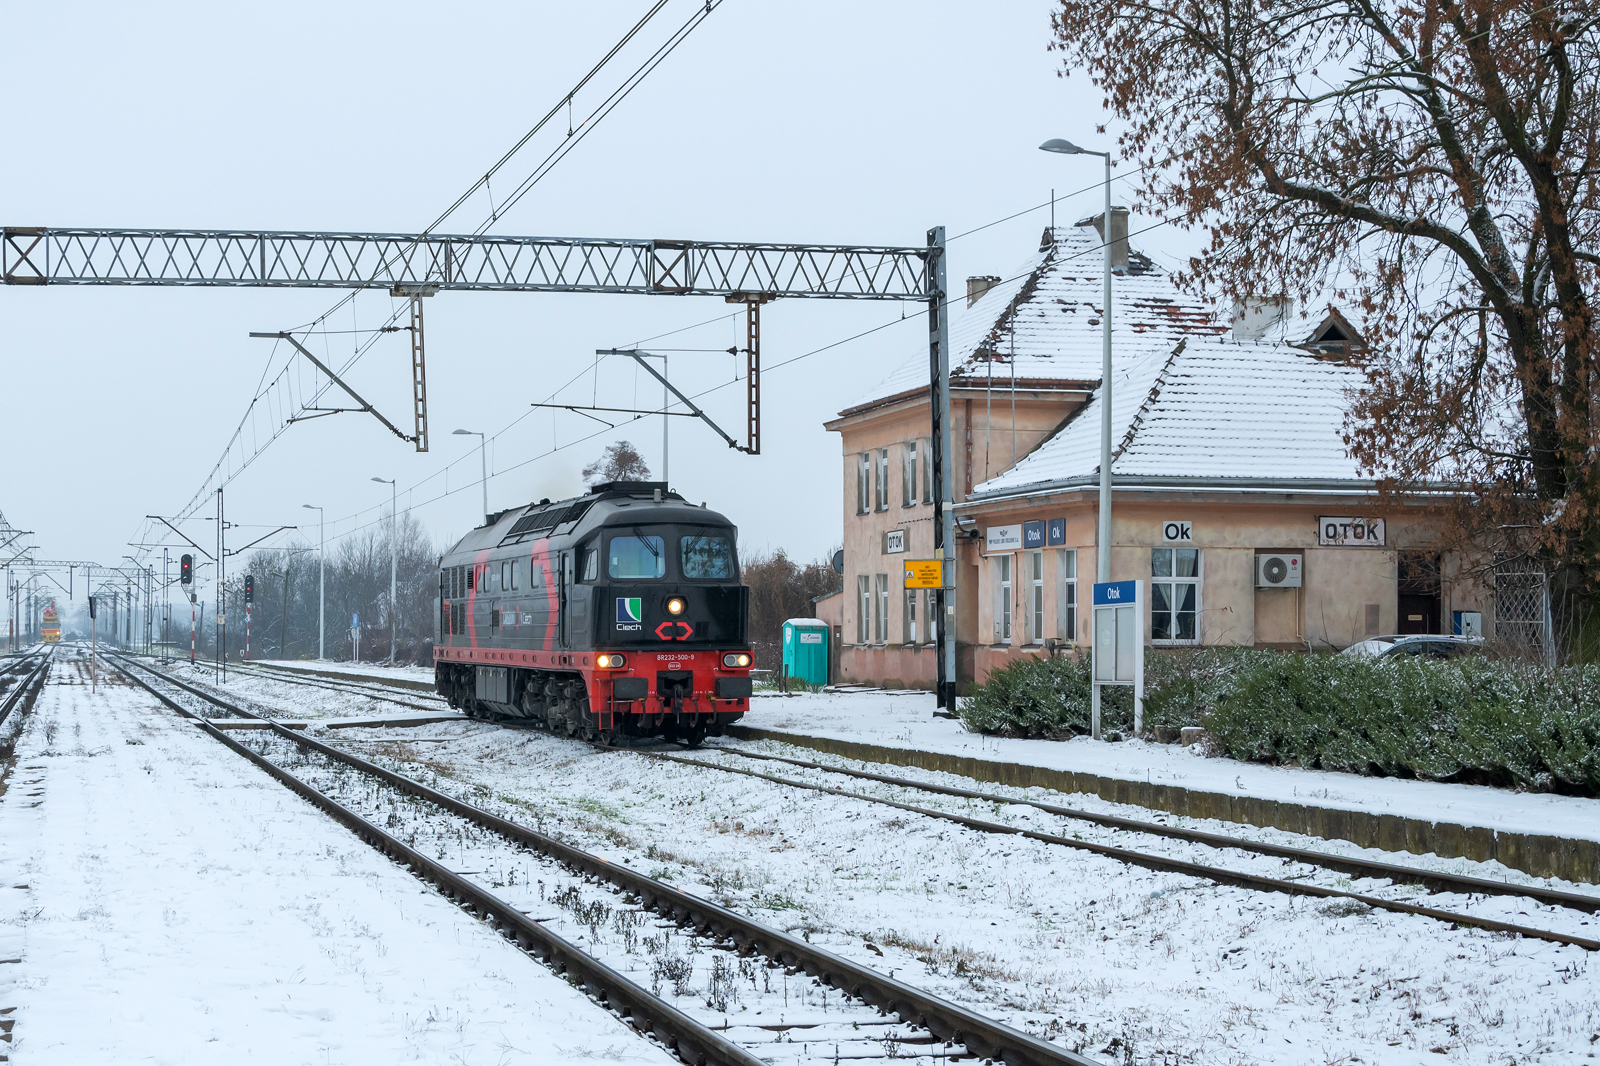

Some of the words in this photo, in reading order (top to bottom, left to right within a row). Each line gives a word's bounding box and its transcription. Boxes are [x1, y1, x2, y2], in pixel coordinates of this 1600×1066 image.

[1028, 529, 1041, 541] Otok
[1052, 527, 1061, 539] Ok
[1165, 523, 1191, 540] Ok
[1325, 523, 1379, 540] OTOK
[889, 535, 903, 549] OTOK
[1107, 586, 1121, 600] Otok
